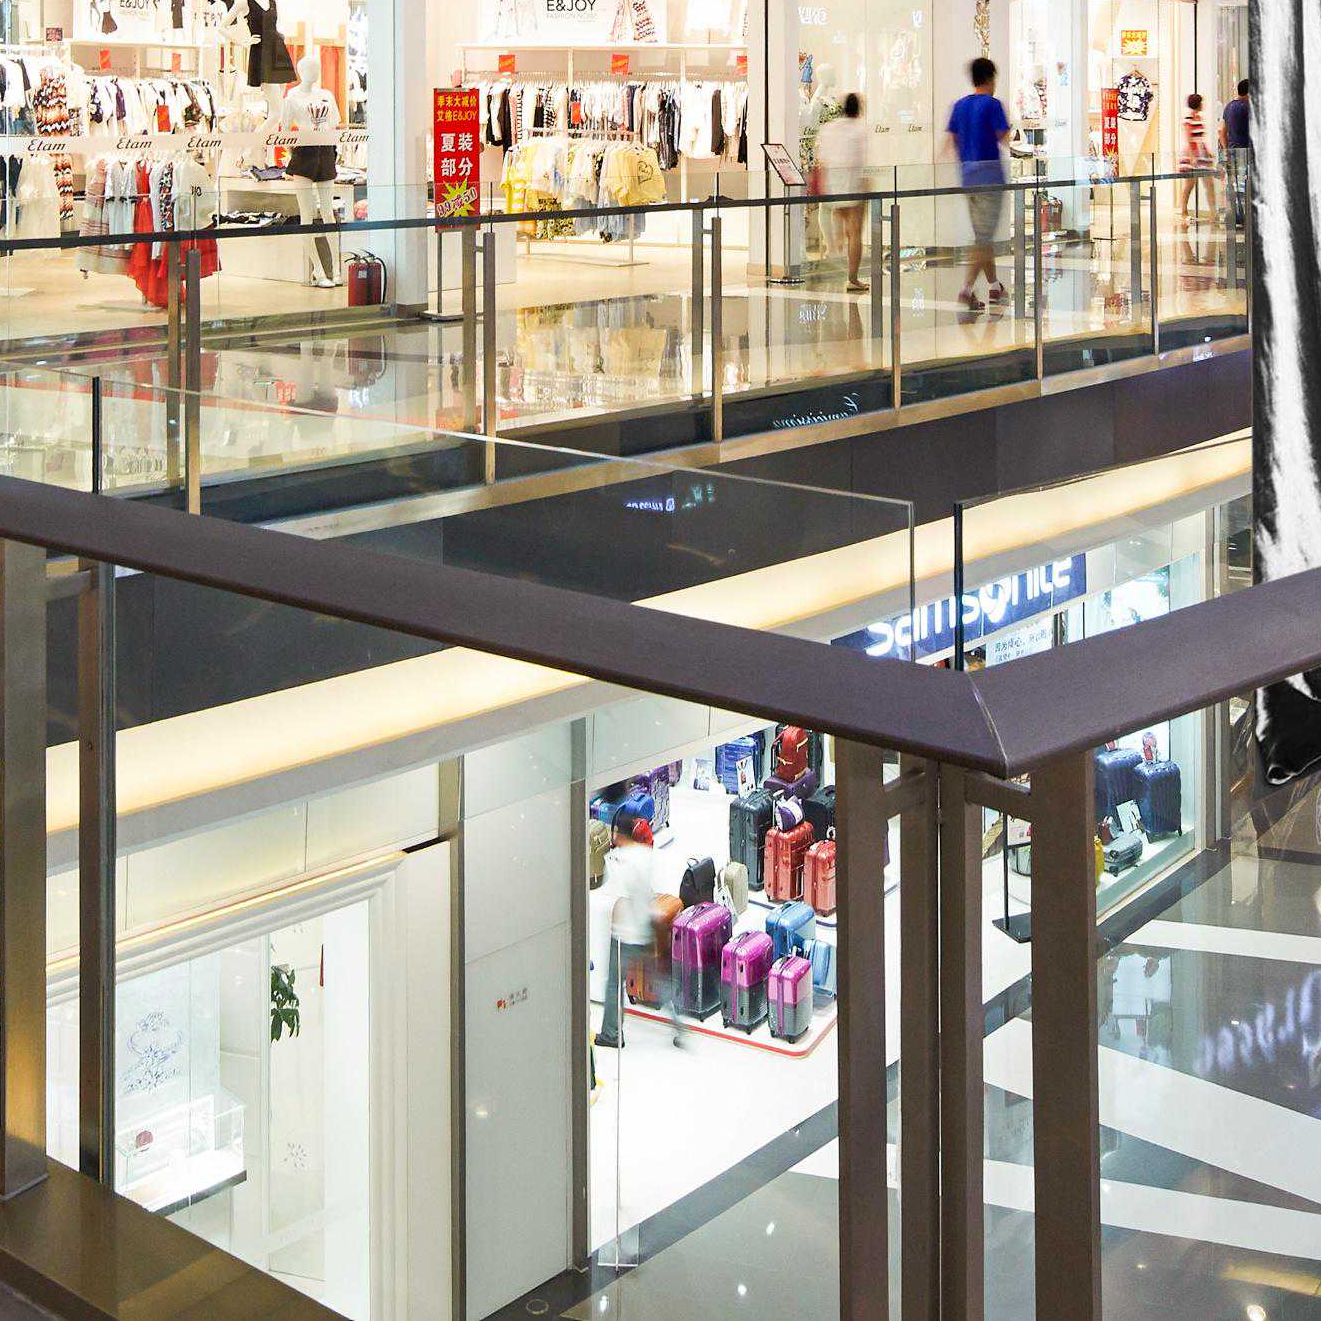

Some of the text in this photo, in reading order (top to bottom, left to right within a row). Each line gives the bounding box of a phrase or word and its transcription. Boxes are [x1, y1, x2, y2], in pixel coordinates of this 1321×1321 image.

[116, 137, 153, 150] Etam
[187, 135, 222, 149] Etam
[266, 134, 298, 146] Etam
[339, 131, 370, 144] Etam
[440, 132, 474, 153] 夏装
[27, 138, 66, 152] Etam
[440, 157, 474, 177] 部分
